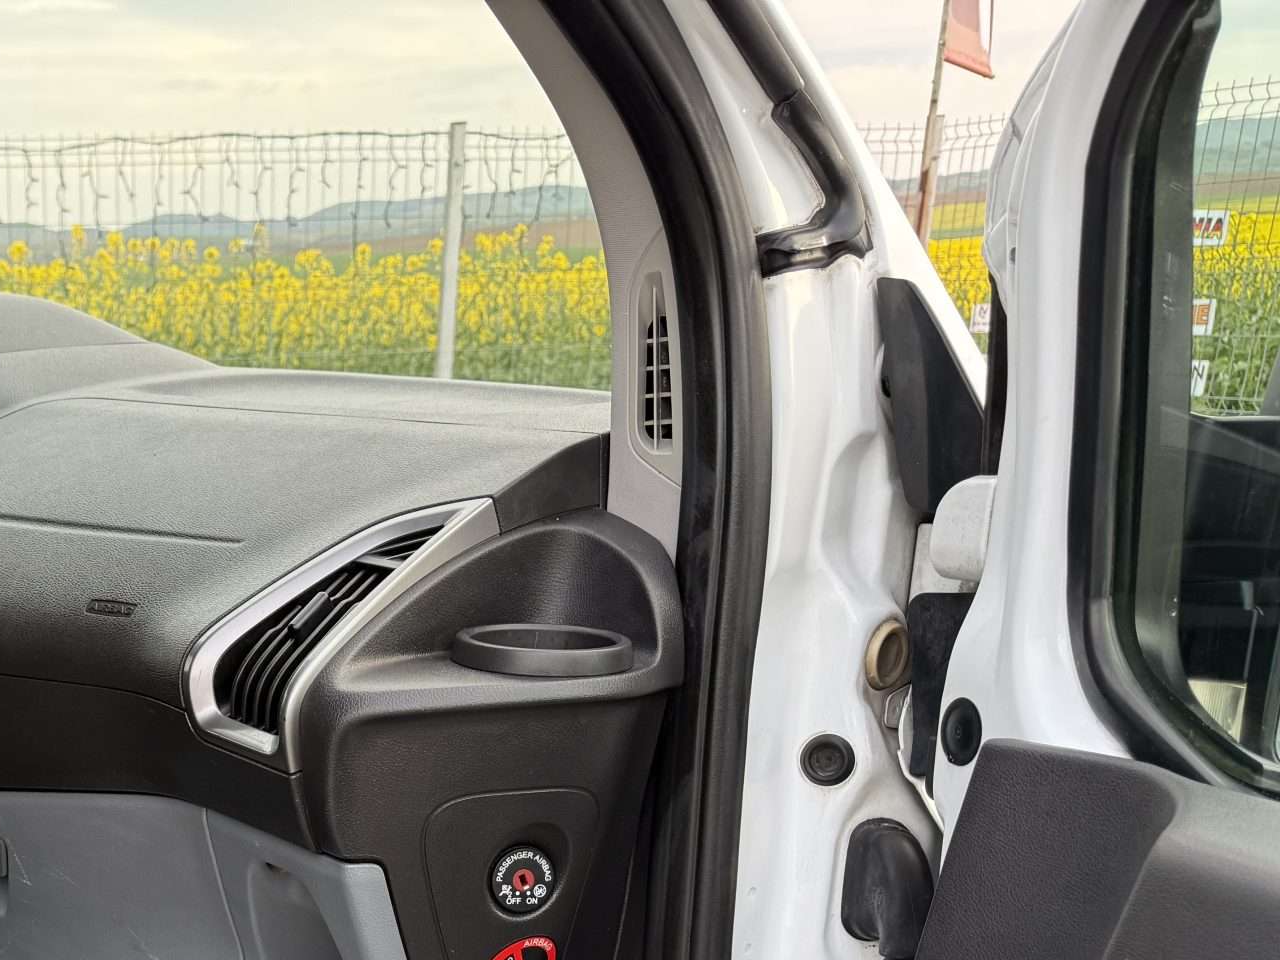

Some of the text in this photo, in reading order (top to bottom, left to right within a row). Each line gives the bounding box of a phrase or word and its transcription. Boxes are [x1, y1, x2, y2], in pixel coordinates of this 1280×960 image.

[496, 851, 552, 882] PASSENGER AIRBAG
[506, 897, 538, 905] OFF ON
[523, 937, 553, 951] AIRBAG
